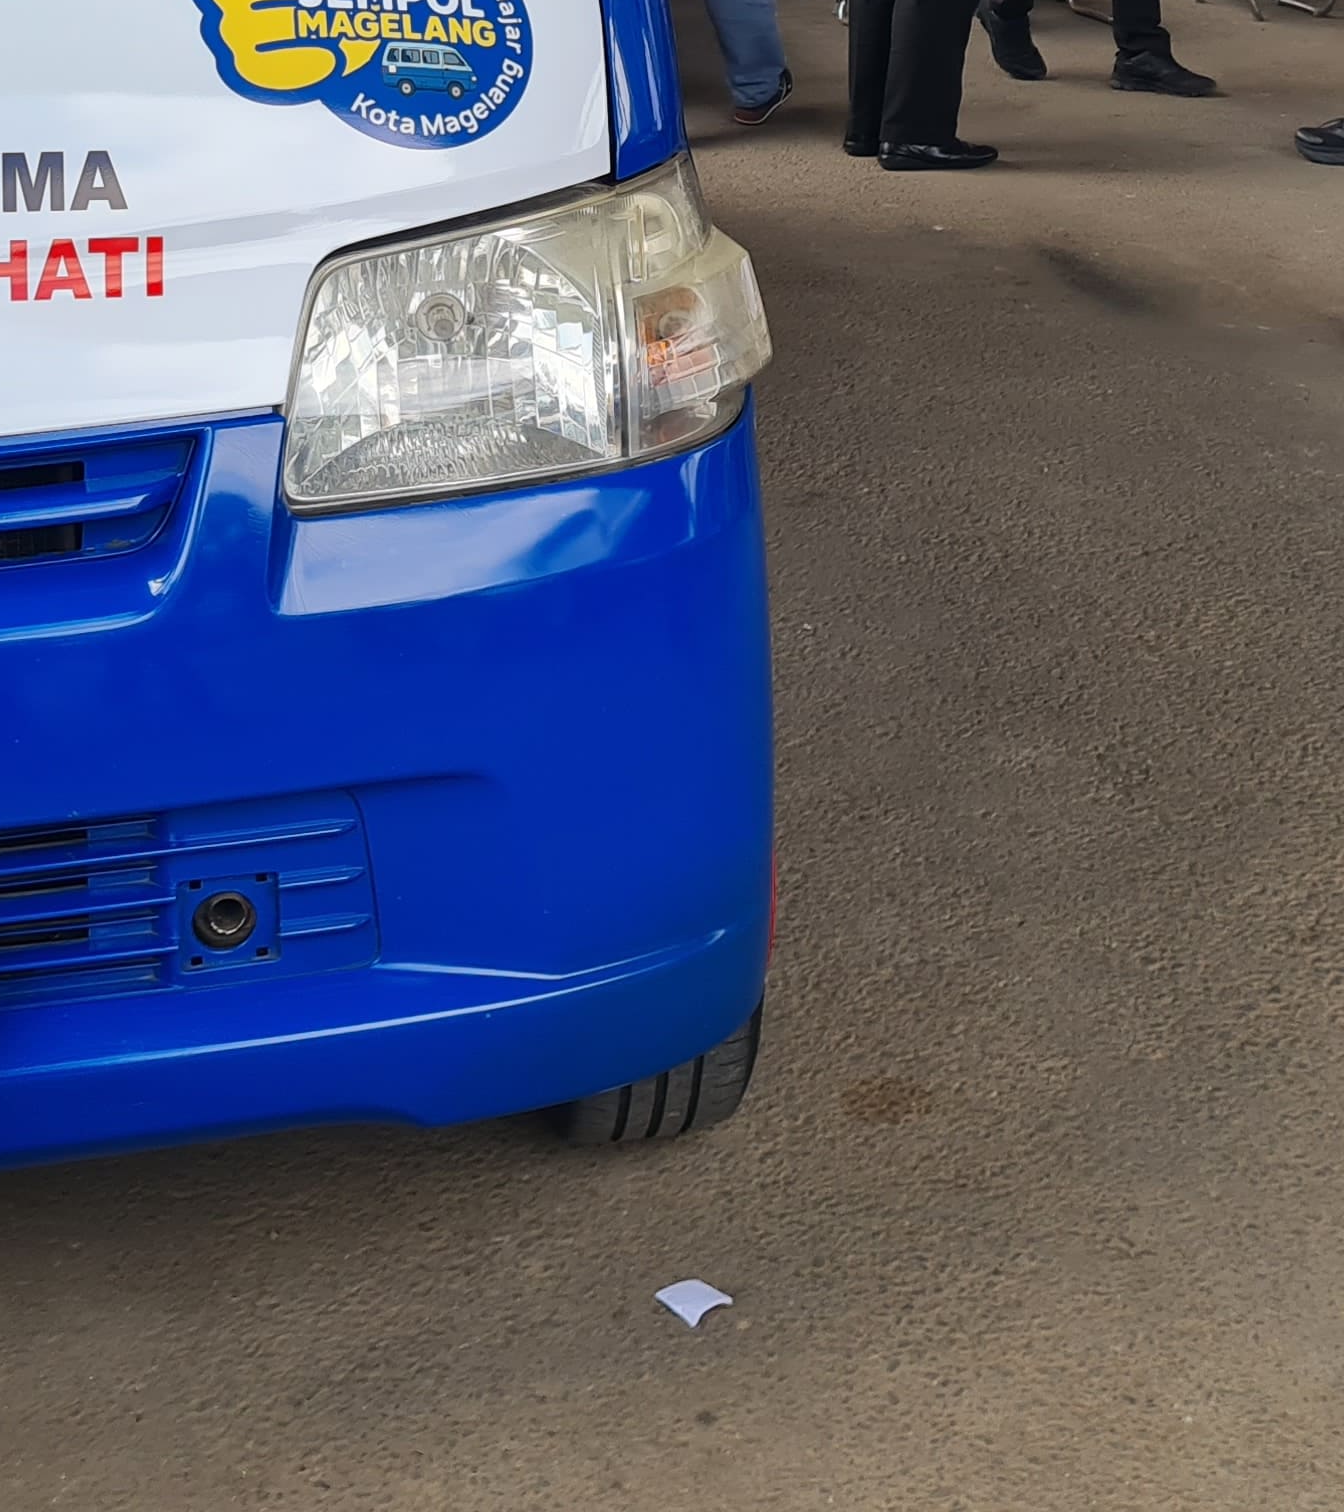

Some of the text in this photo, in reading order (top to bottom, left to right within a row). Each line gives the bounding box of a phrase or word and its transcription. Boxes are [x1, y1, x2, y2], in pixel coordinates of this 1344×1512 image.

[296, 9, 497, 48] MAGELANG
[350, 57, 525, 138] Kota Magelang
